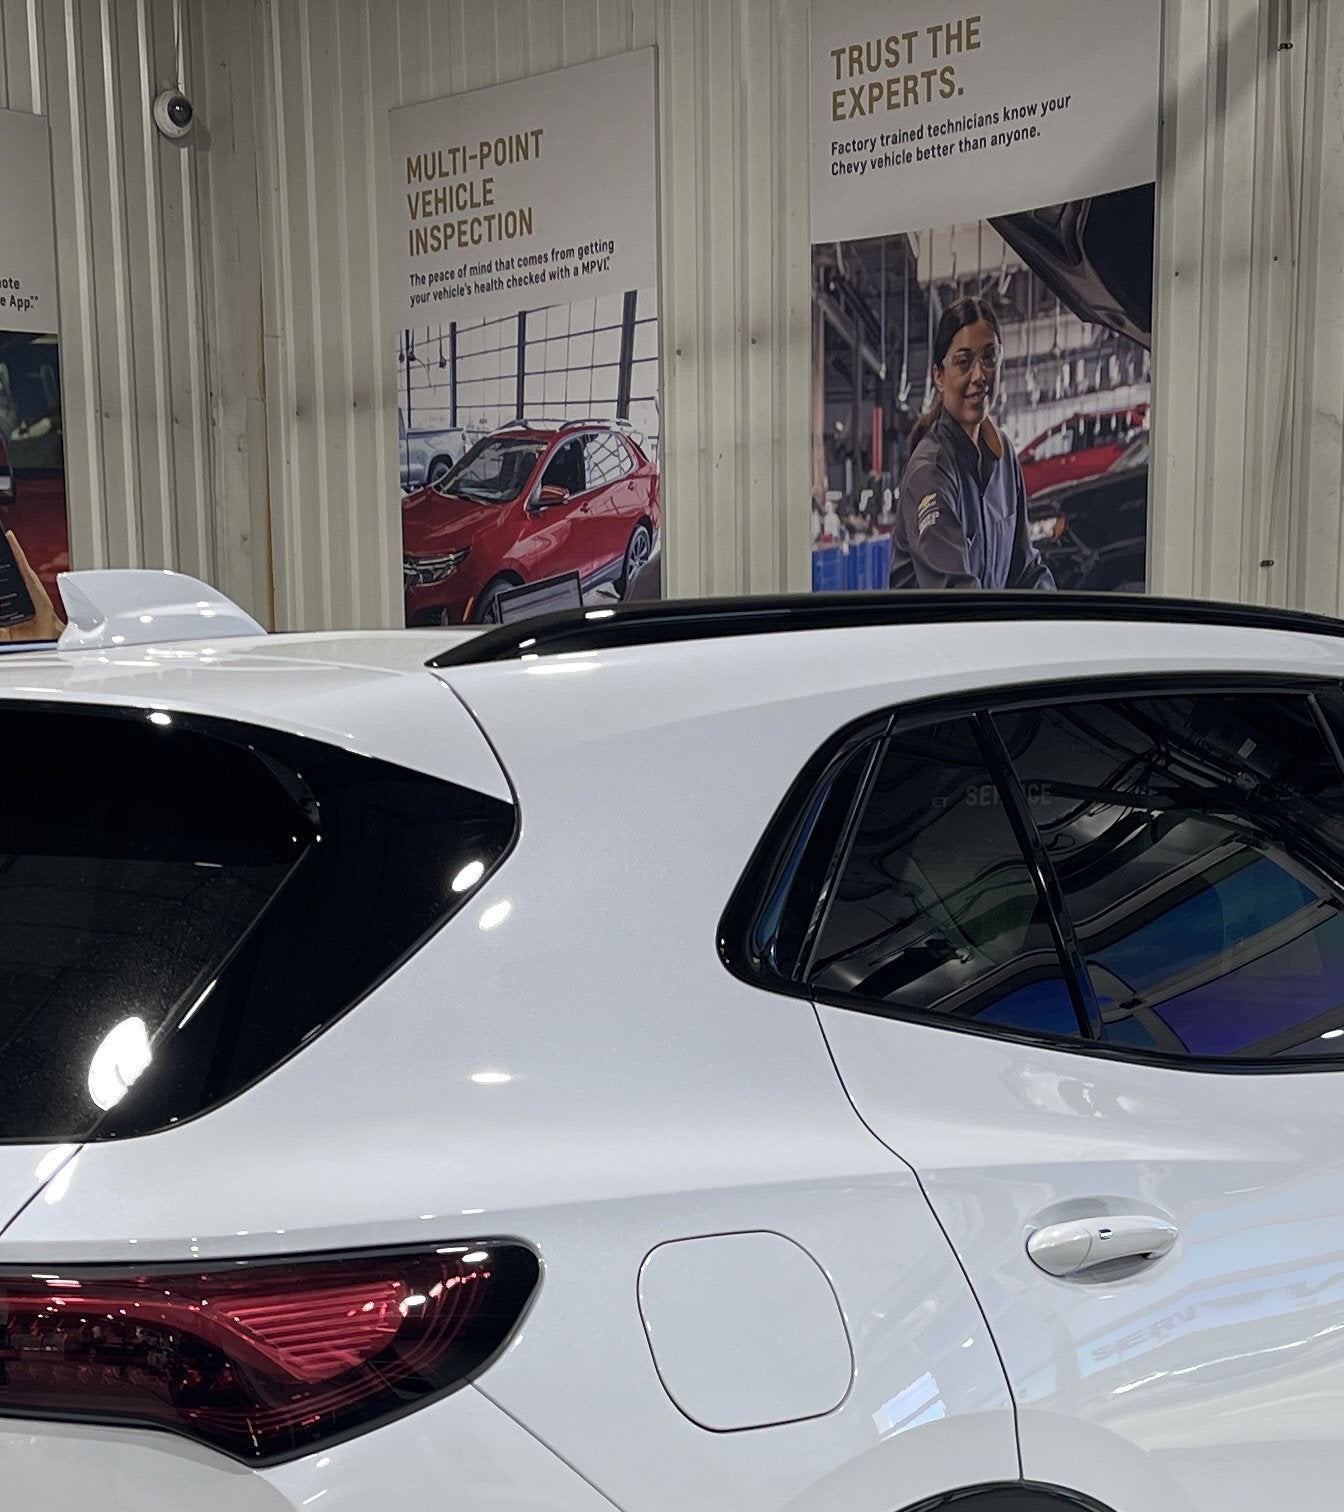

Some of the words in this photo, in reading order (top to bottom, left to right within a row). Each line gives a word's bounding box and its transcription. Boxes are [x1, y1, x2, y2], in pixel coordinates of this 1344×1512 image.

[831, 31, 918, 80] TRUST
[927, 16, 981, 58] THE
[832, 66, 964, 122] EXPERTS.
[831, 135, 877, 156] Factory
[880, 125, 924, 147] trained
[927, 111, 999, 137] technicians
[1003, 103, 1037, 122] know
[1040, 95, 1071, 117] your
[407, 129, 543, 184] MULTI-POINT
[831, 156, 867, 176] Chevy
[870, 148, 913, 170] vehicle
[916, 142, 955, 162] better
[958, 136, 987, 153] than
[990, 126, 1041, 147] anyone.
[407, 177, 494, 220] VEHICLE
[409, 207, 533, 256] INSPECTION
[410, 273, 426, 288] The
[428, 269, 455, 287] peace
[457, 263, 468, 278] of
[470, 259, 493, 277] mind
[495, 255, 515, 273] that
[517, 252, 548, 269] comes
[551, 247, 575, 263] from
[578, 239, 615, 261] getting
[410, 290, 431, 308] your
[433, 283, 473, 302] vehicle's
[474, 276, 504, 295] health
[506, 270, 546, 289] checked
[549, 264, 571, 281] with
[573, 266, 579, 277] a
